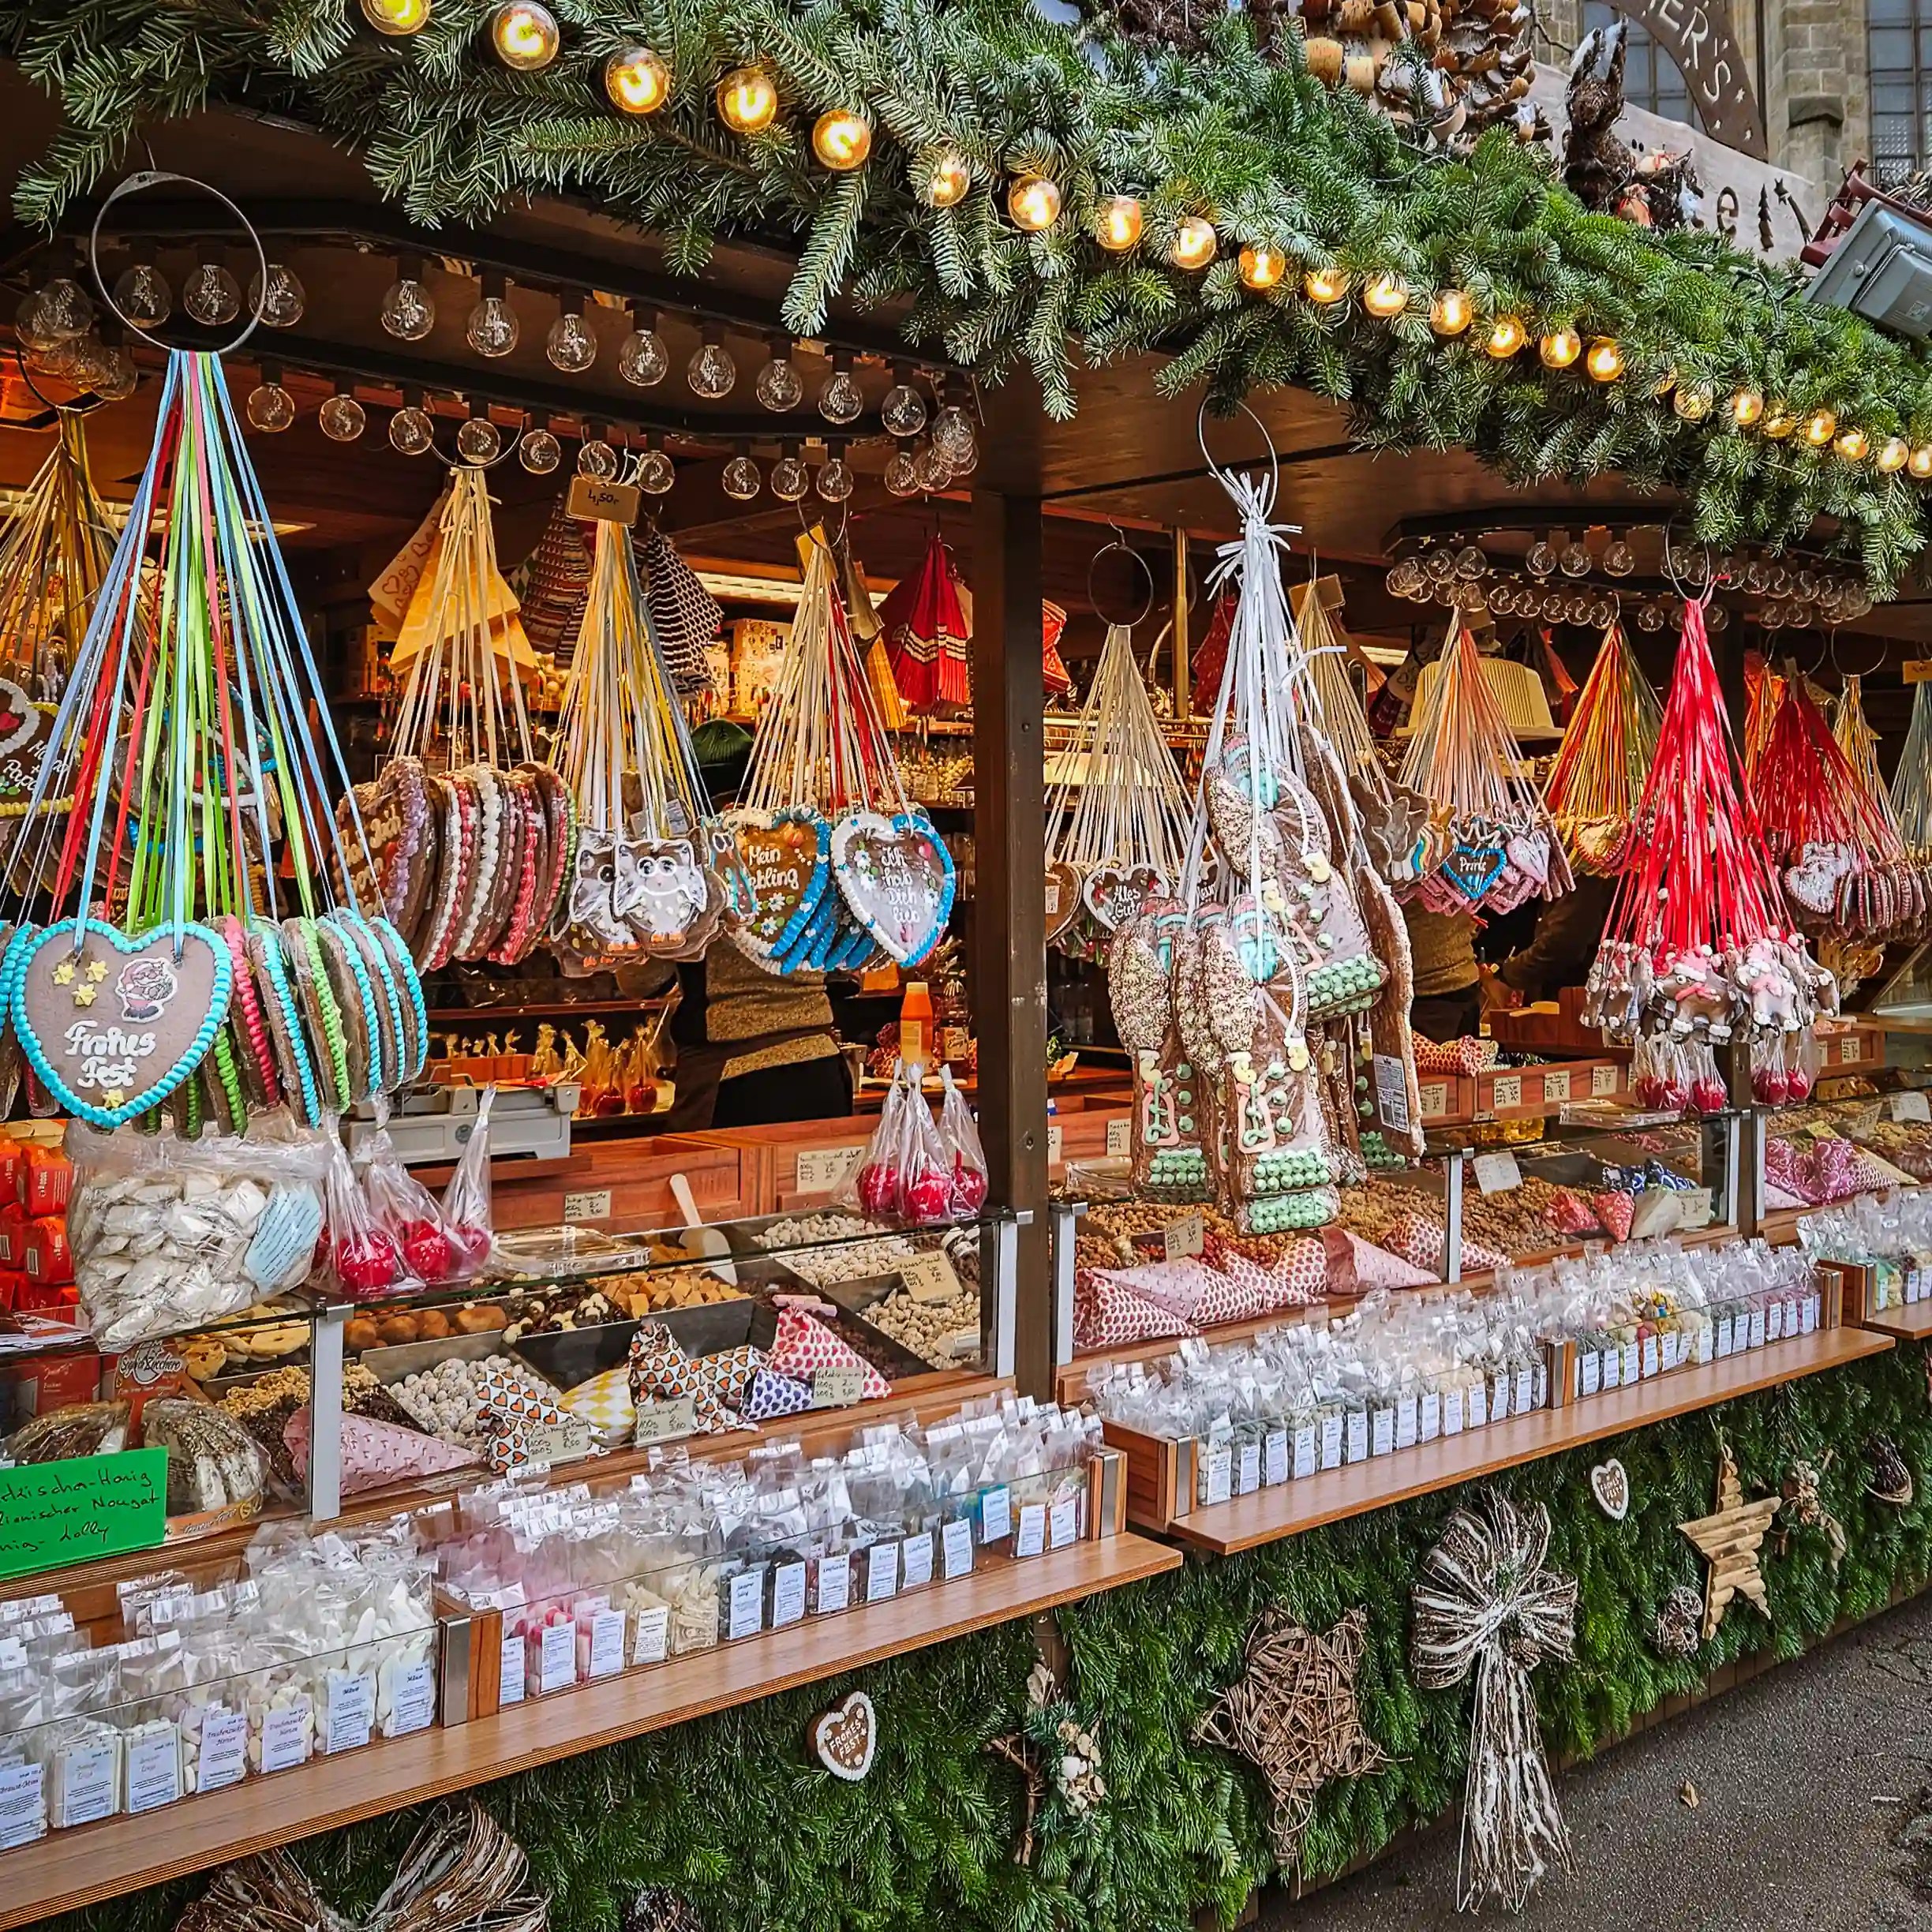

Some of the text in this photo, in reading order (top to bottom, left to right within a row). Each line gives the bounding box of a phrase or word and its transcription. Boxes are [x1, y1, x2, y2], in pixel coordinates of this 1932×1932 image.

[749, 844, 782, 867] Mein
[880, 845, 907, 867] Ich
[750, 868, 800, 890] ebling
[882, 871, 913, 889] hab
[885, 887, 918, 905] Dich
[1113, 885, 1141, 903] Alles
[891, 905, 921, 924] lieb
[64, 1020, 157, 1057] Frohes
[77, 1056, 138, 1088] Fest
[92, 1489, 160, 1513] Nougat
[0, 1521, 110, 1552] nig- Lolly
[829, 1719, 861, 1753] FROHES
[839, 1733, 861, 1760] FEST
